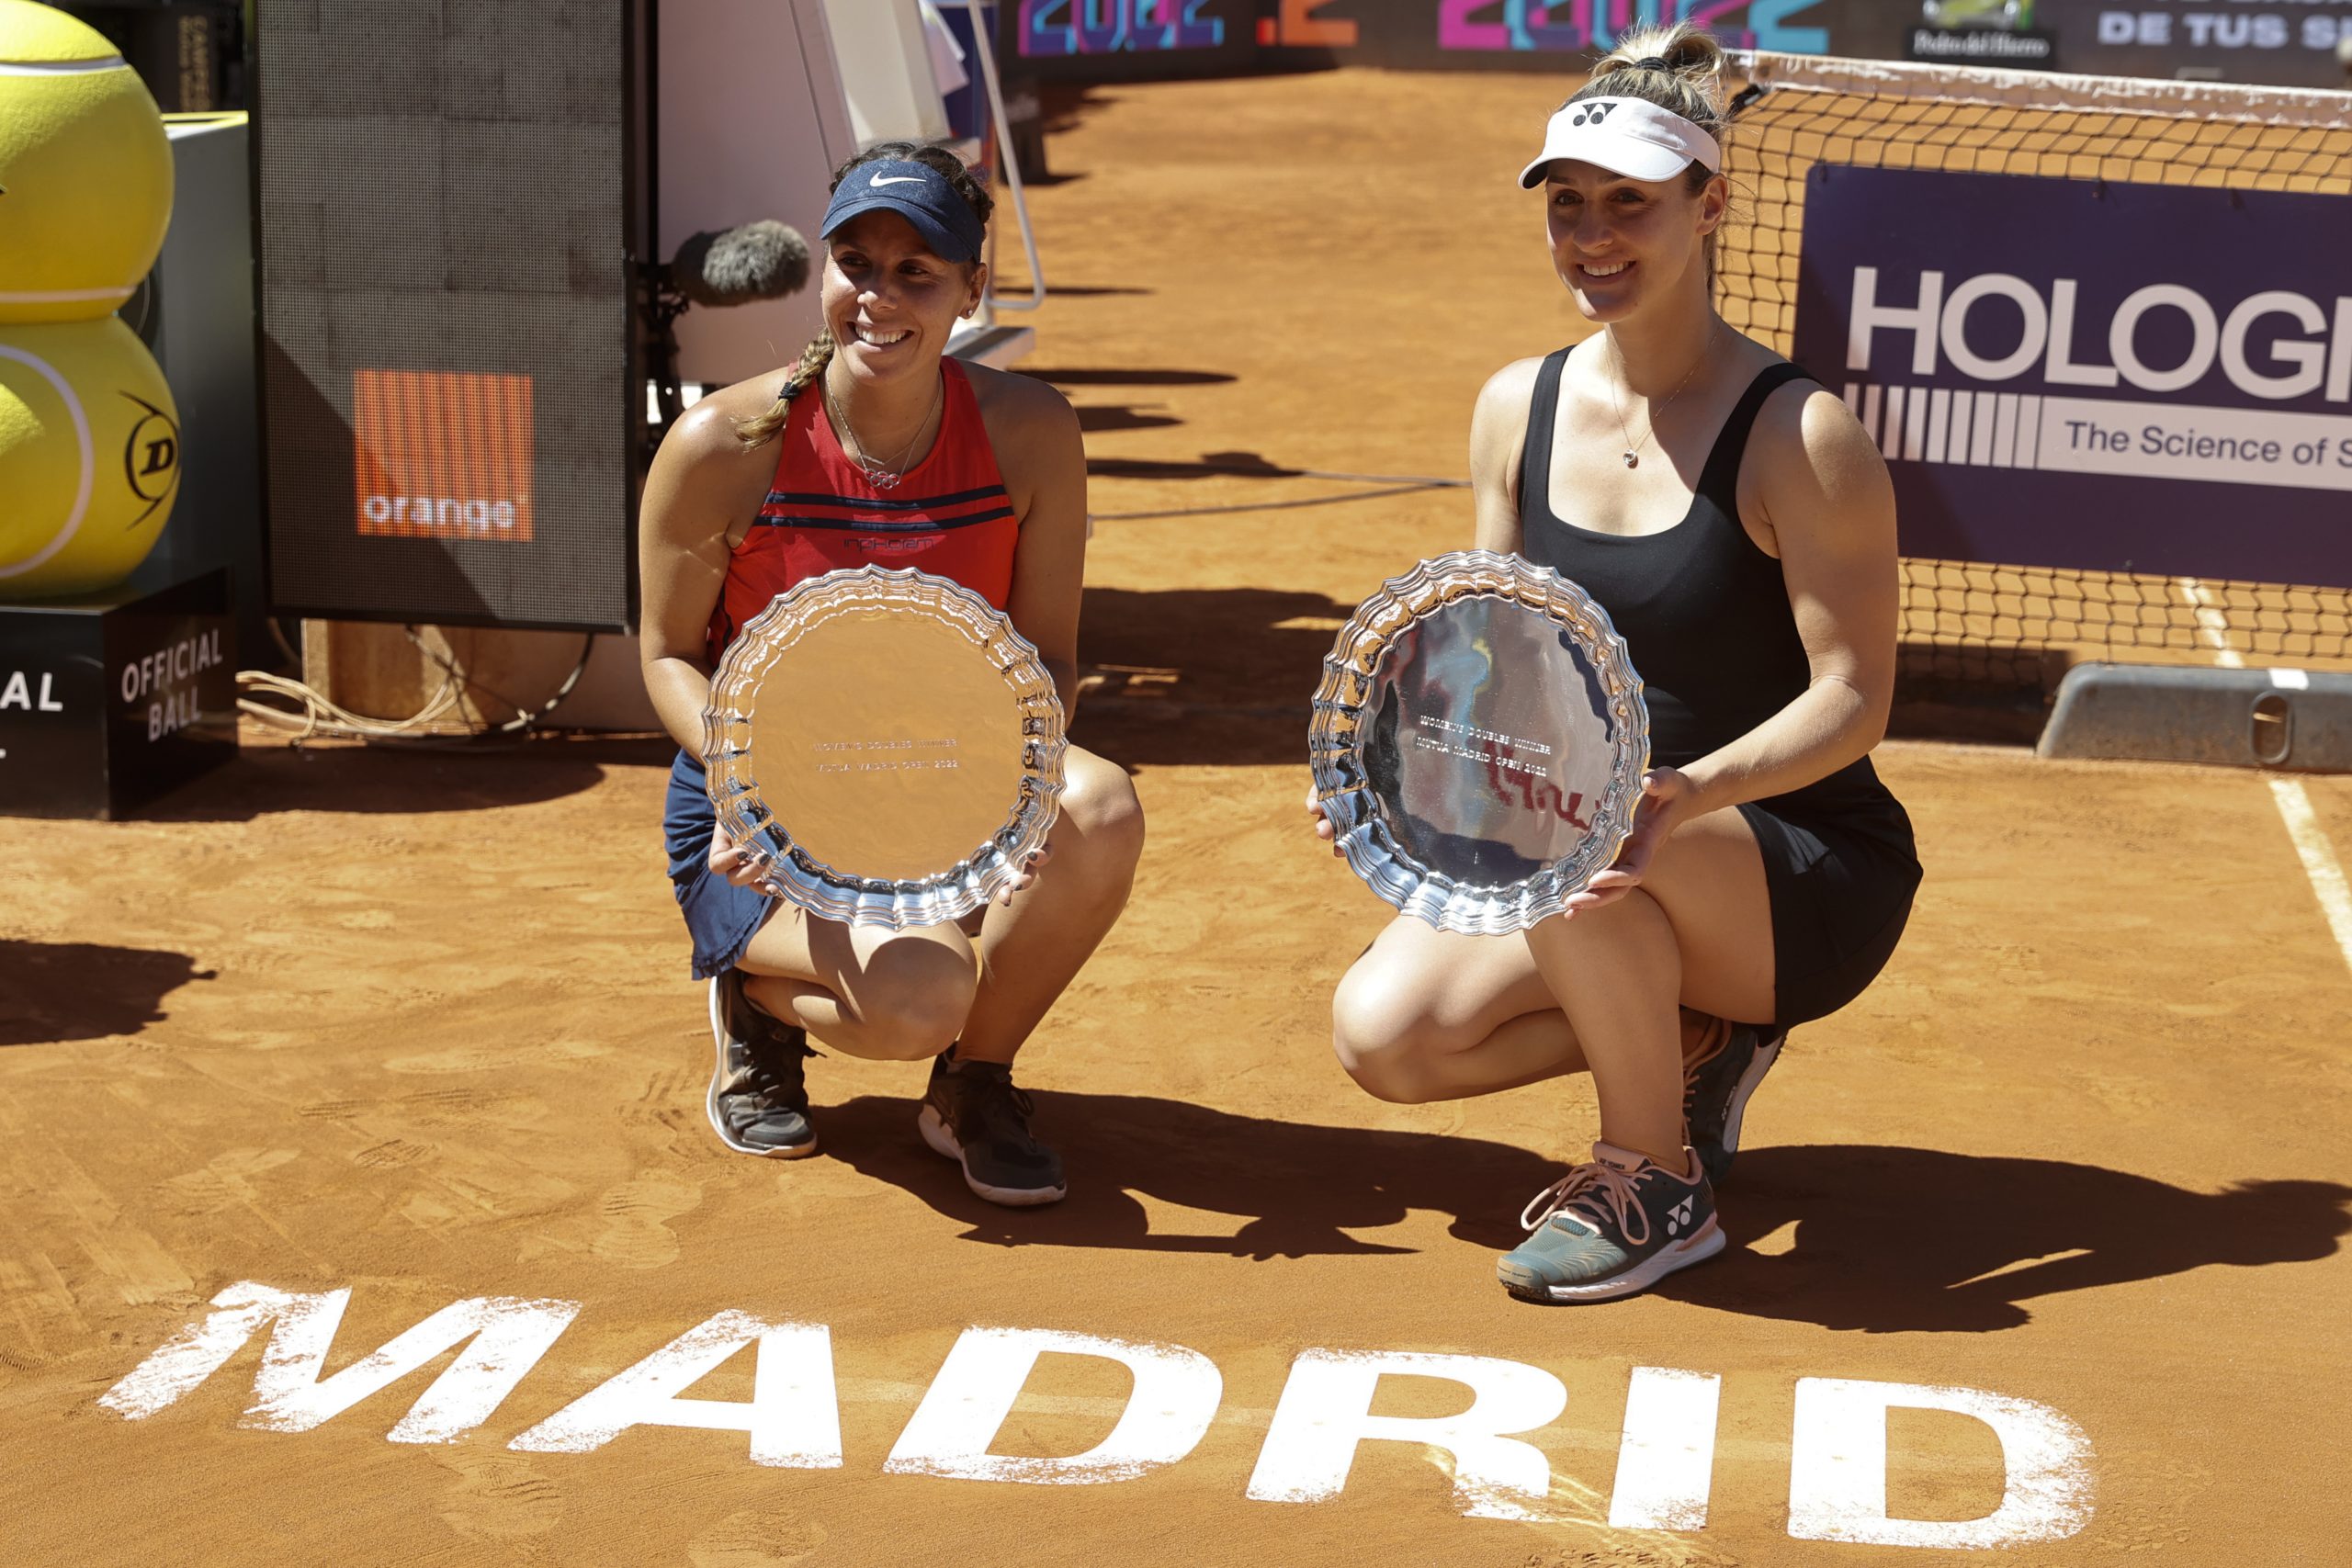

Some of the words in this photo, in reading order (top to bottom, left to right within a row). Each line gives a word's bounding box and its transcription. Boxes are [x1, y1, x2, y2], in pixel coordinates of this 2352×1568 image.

[2098, 10, 2173, 46] DE
[2182, 12, 2290, 50] TUS
[2064, 420, 2131, 453] The
[2140, 424, 2281, 463] Science
[2292, 436, 2328, 466] of
[364, 495, 515, 534] orange
[121, 628, 223, 704] OFFICIAL
[148, 685, 203, 743] BALL
[1453, 745, 1491, 763] MADRID
[1495, 756, 1521, 771] OPEN
[1523, 763, 1547, 777] 2022
[98, 1280, 2095, 1552] MADRID
